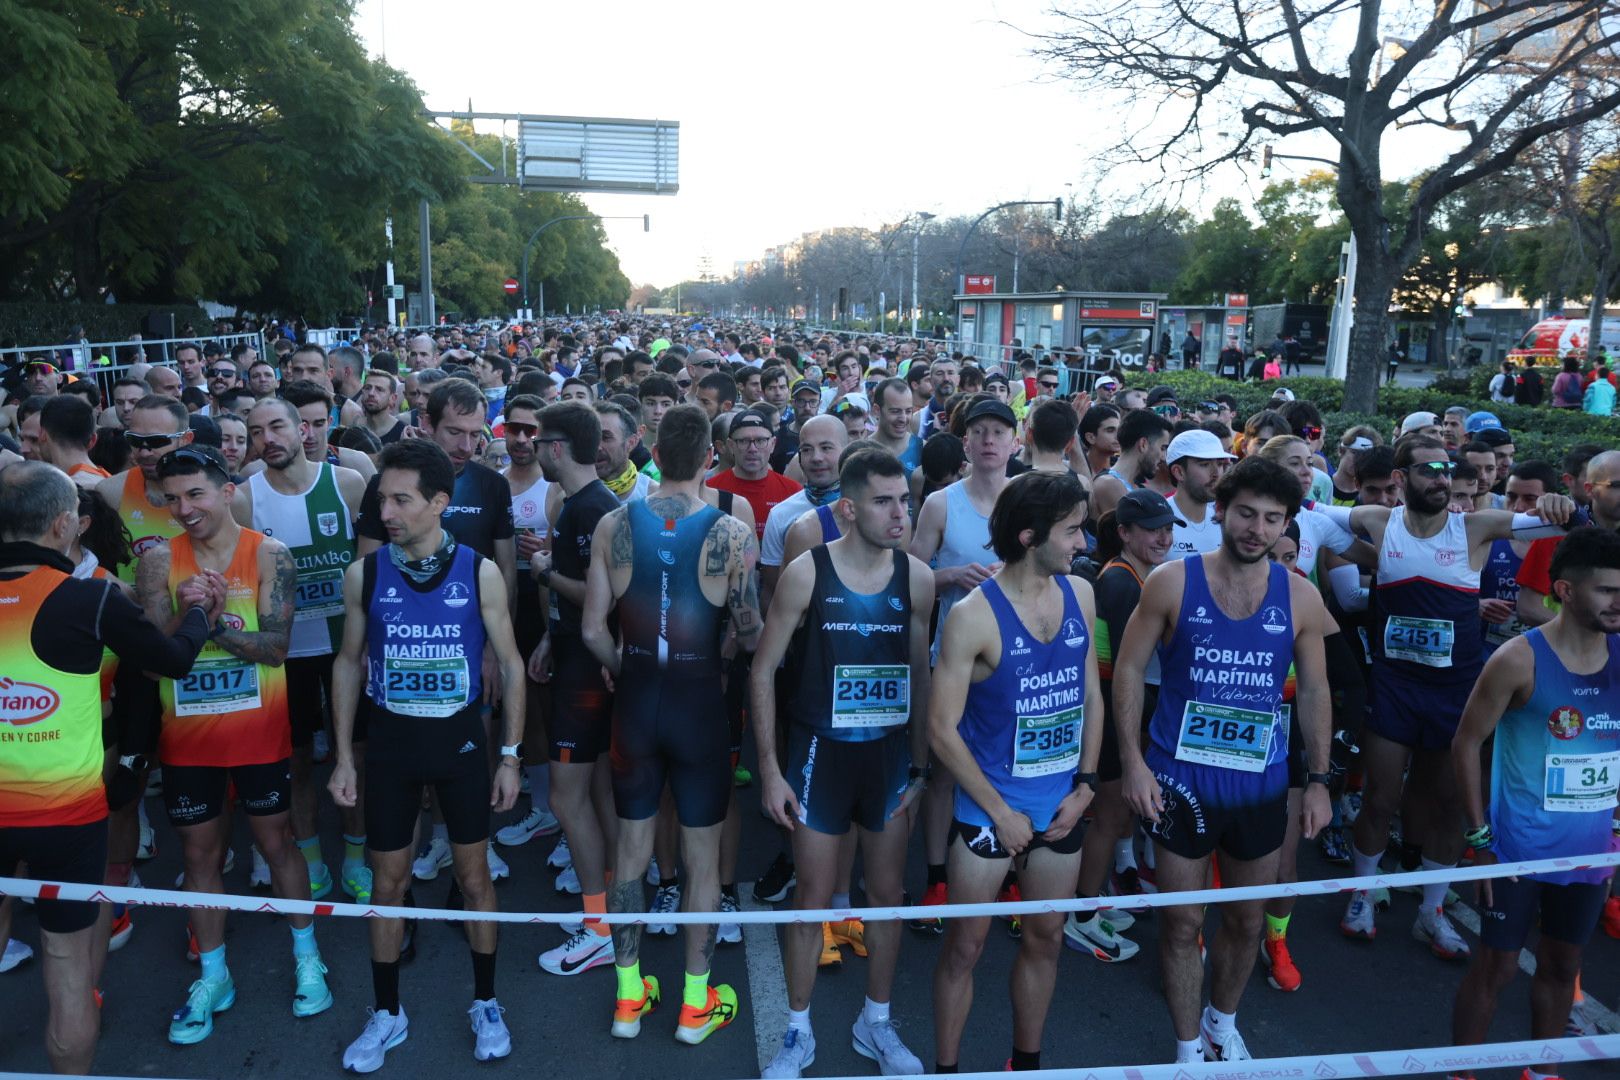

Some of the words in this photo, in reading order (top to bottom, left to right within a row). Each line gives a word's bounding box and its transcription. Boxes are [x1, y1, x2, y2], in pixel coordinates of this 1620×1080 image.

[1188, 616, 1213, 624] VIATOR
[386, 624, 461, 638] POBLATS
[1391, 628, 1440, 646] 2151
[384, 641, 464, 658] MARÍTIMS
[1194, 646, 1274, 667] POBLATS
[182, 670, 244, 692] 2017
[389, 672, 456, 692] 2389
[1020, 666, 1078, 692] POBLATS
[1189, 666, 1274, 687] MARÍTIMS
[838, 680, 898, 701] 2346
[1015, 687, 1080, 714] MARÍTIMS
[0, 695, 50, 710] rano
[17, 732, 24, 742] Y
[27, 729, 60, 743] CORRE
[1019, 723, 1074, 751] 2385
[1188, 716, 1255, 744] 2164
[1581, 767, 1610, 787] 34
